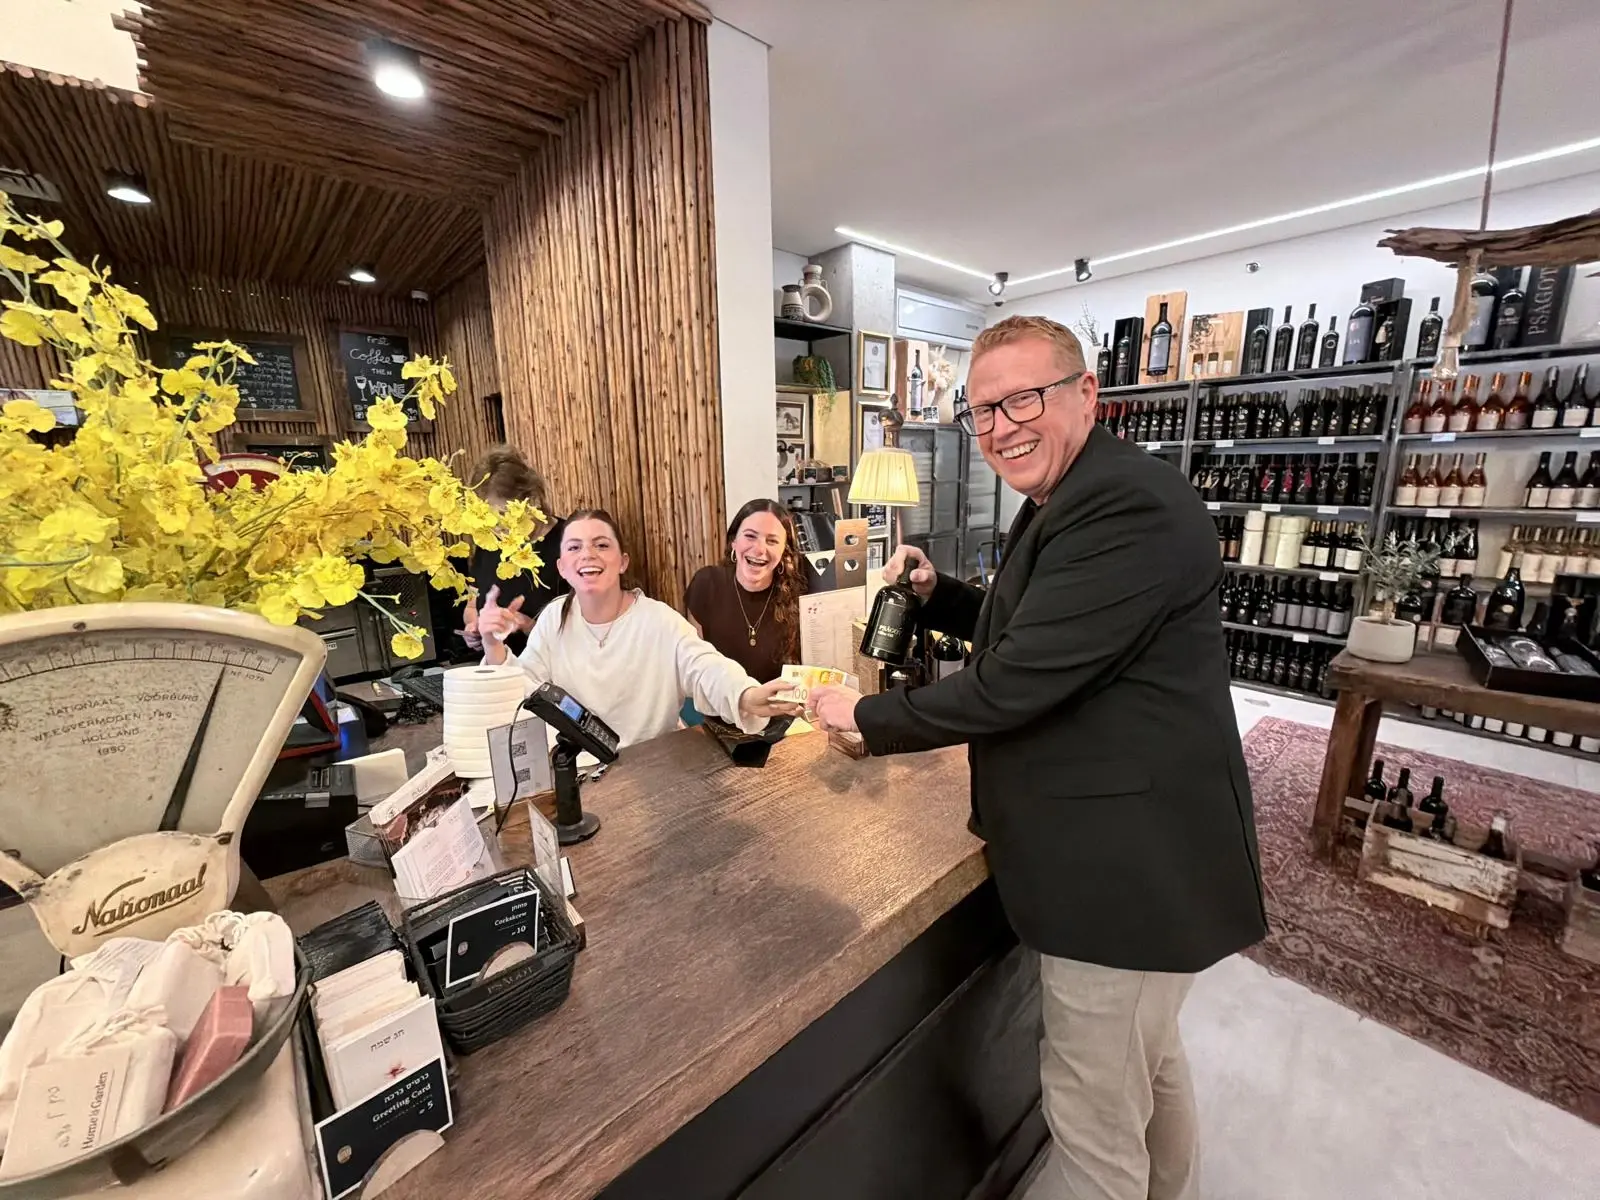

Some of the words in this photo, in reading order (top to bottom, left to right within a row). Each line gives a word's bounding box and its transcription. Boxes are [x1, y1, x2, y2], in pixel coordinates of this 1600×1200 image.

[349, 348, 392, 365] Coffee
[368, 380, 406, 399] WINE
[80, 727, 141, 745] HOLLAND
[71, 862, 207, 936] Nationaal
[370, 1036, 392, 1053] שמח
[90, 1071, 109, 1109] Garden
[372, 1096, 410, 1123] Greeting
[411, 1083, 432, 1099] Card
